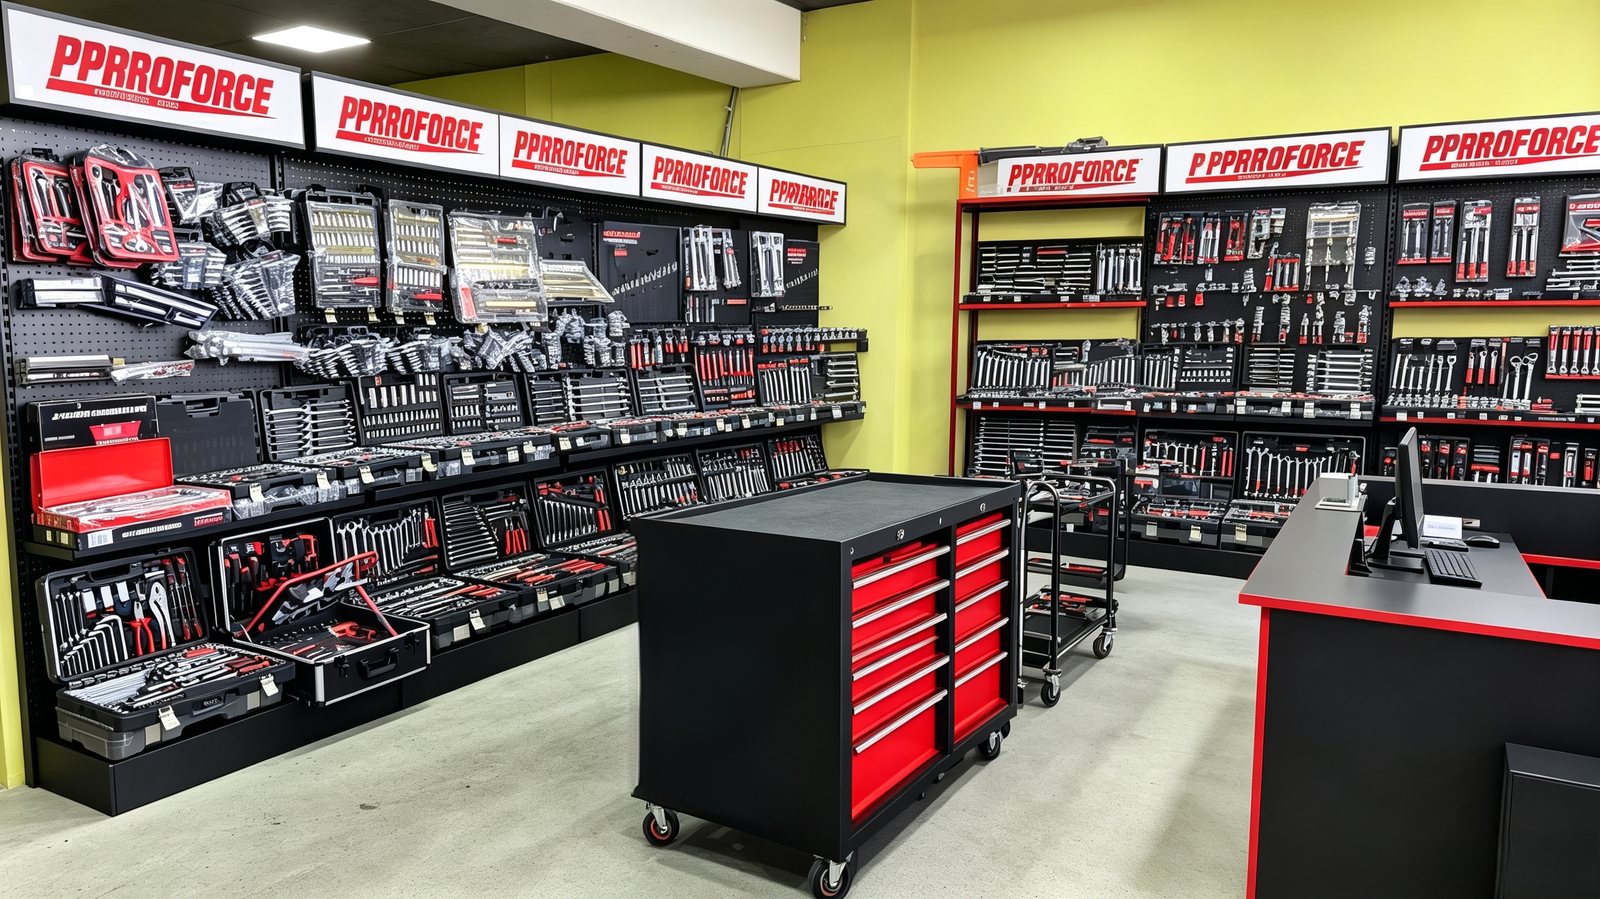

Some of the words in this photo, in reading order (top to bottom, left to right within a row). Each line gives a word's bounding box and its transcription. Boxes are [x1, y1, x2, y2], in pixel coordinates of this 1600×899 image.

[50, 35, 274, 116] PPRROFORCE
[338, 95, 484, 152] PPRROFORCE
[513, 130, 628, 175] PPRROFORCE
